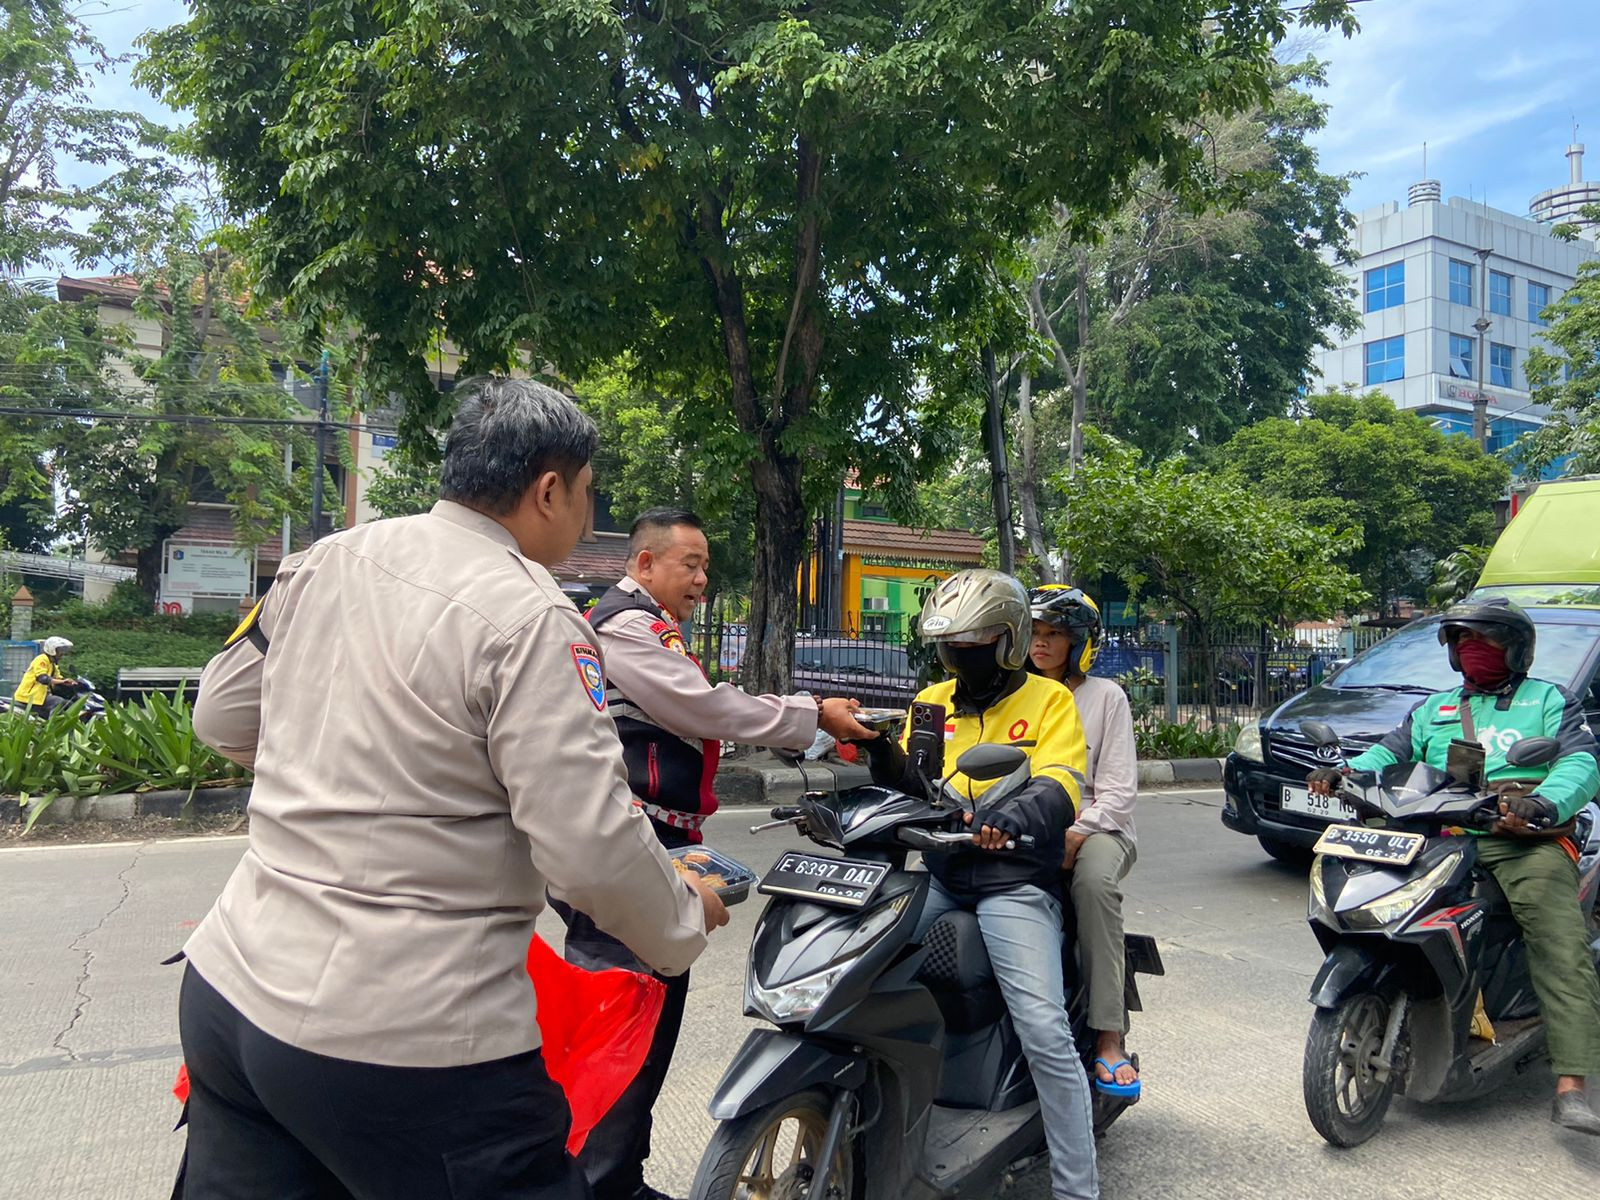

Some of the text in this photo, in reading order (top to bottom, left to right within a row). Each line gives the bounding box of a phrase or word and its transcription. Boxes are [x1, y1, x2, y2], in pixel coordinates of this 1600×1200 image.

[1459, 390, 1498, 404] HOA
[1285, 789, 1291, 802] B
[1307, 793, 1329, 809] 518
[1327, 829, 1338, 839] B
[1342, 831, 1379, 845] 3550
[780, 859, 794, 872] E
[795, 860, 839, 878] 6397
[1461, 909, 1484, 929] HONDA
